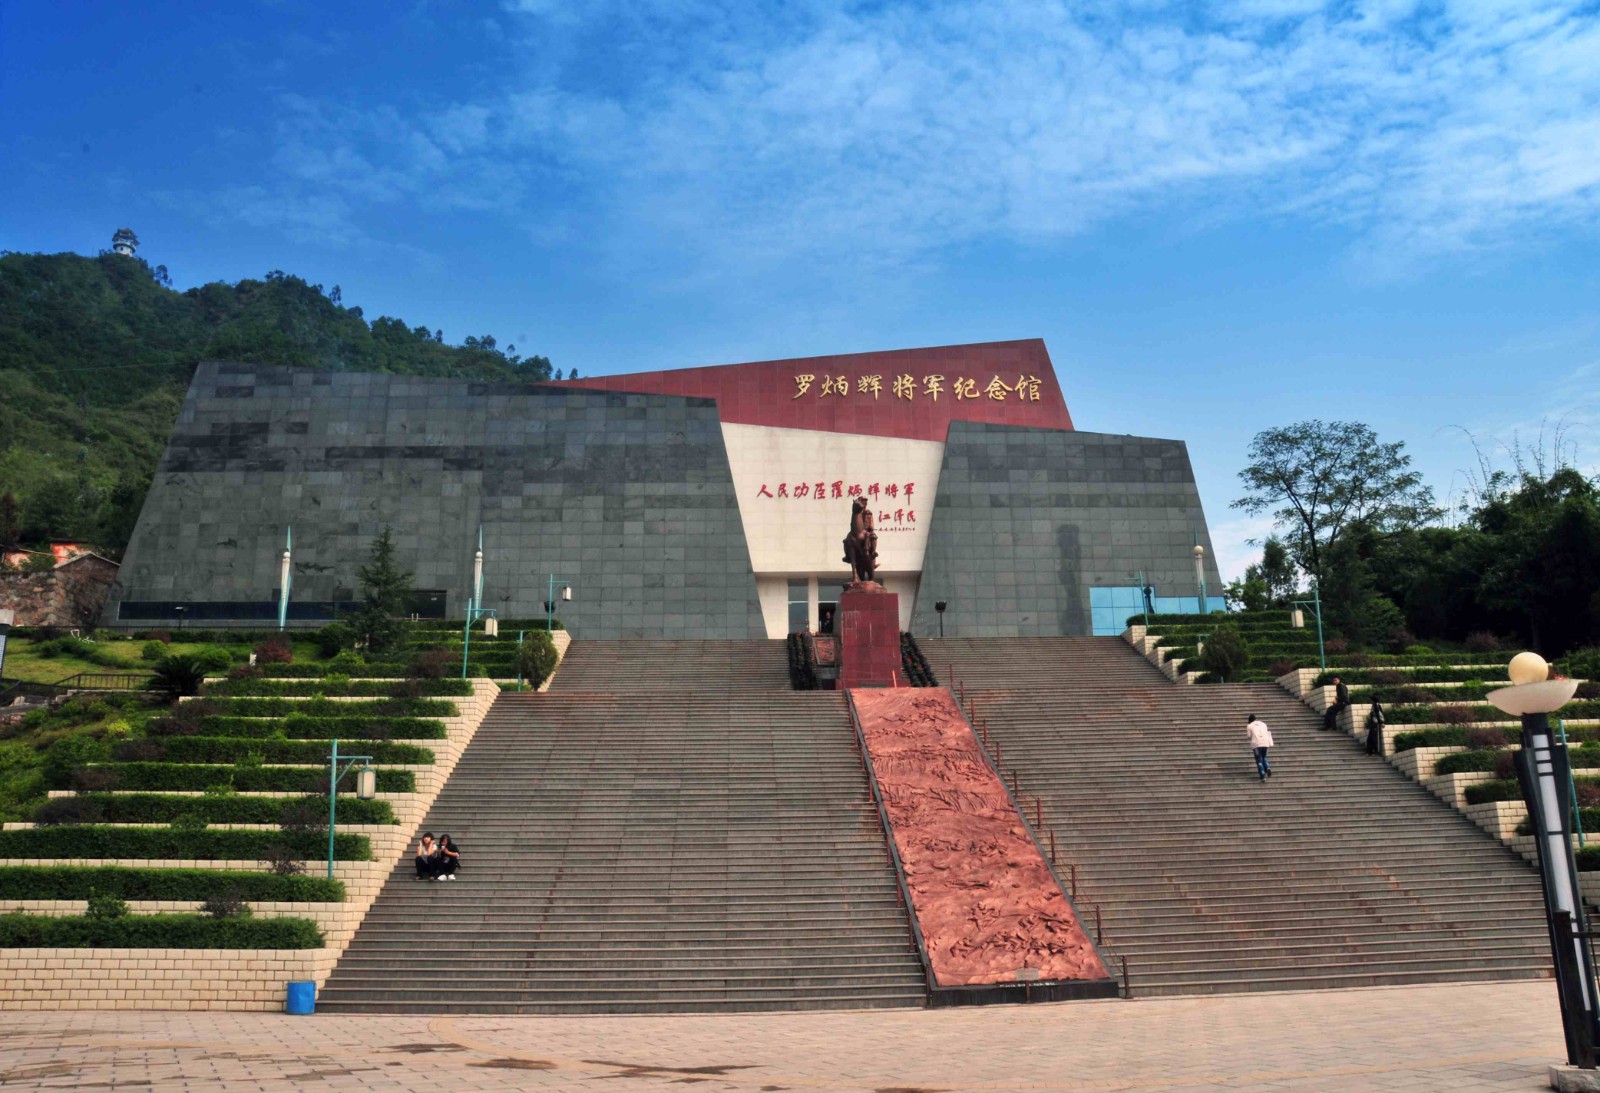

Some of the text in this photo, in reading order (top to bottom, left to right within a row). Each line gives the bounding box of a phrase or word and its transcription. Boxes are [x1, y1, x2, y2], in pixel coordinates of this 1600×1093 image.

[792, 373, 1042, 402] 罗炳辉将军纪念馆
